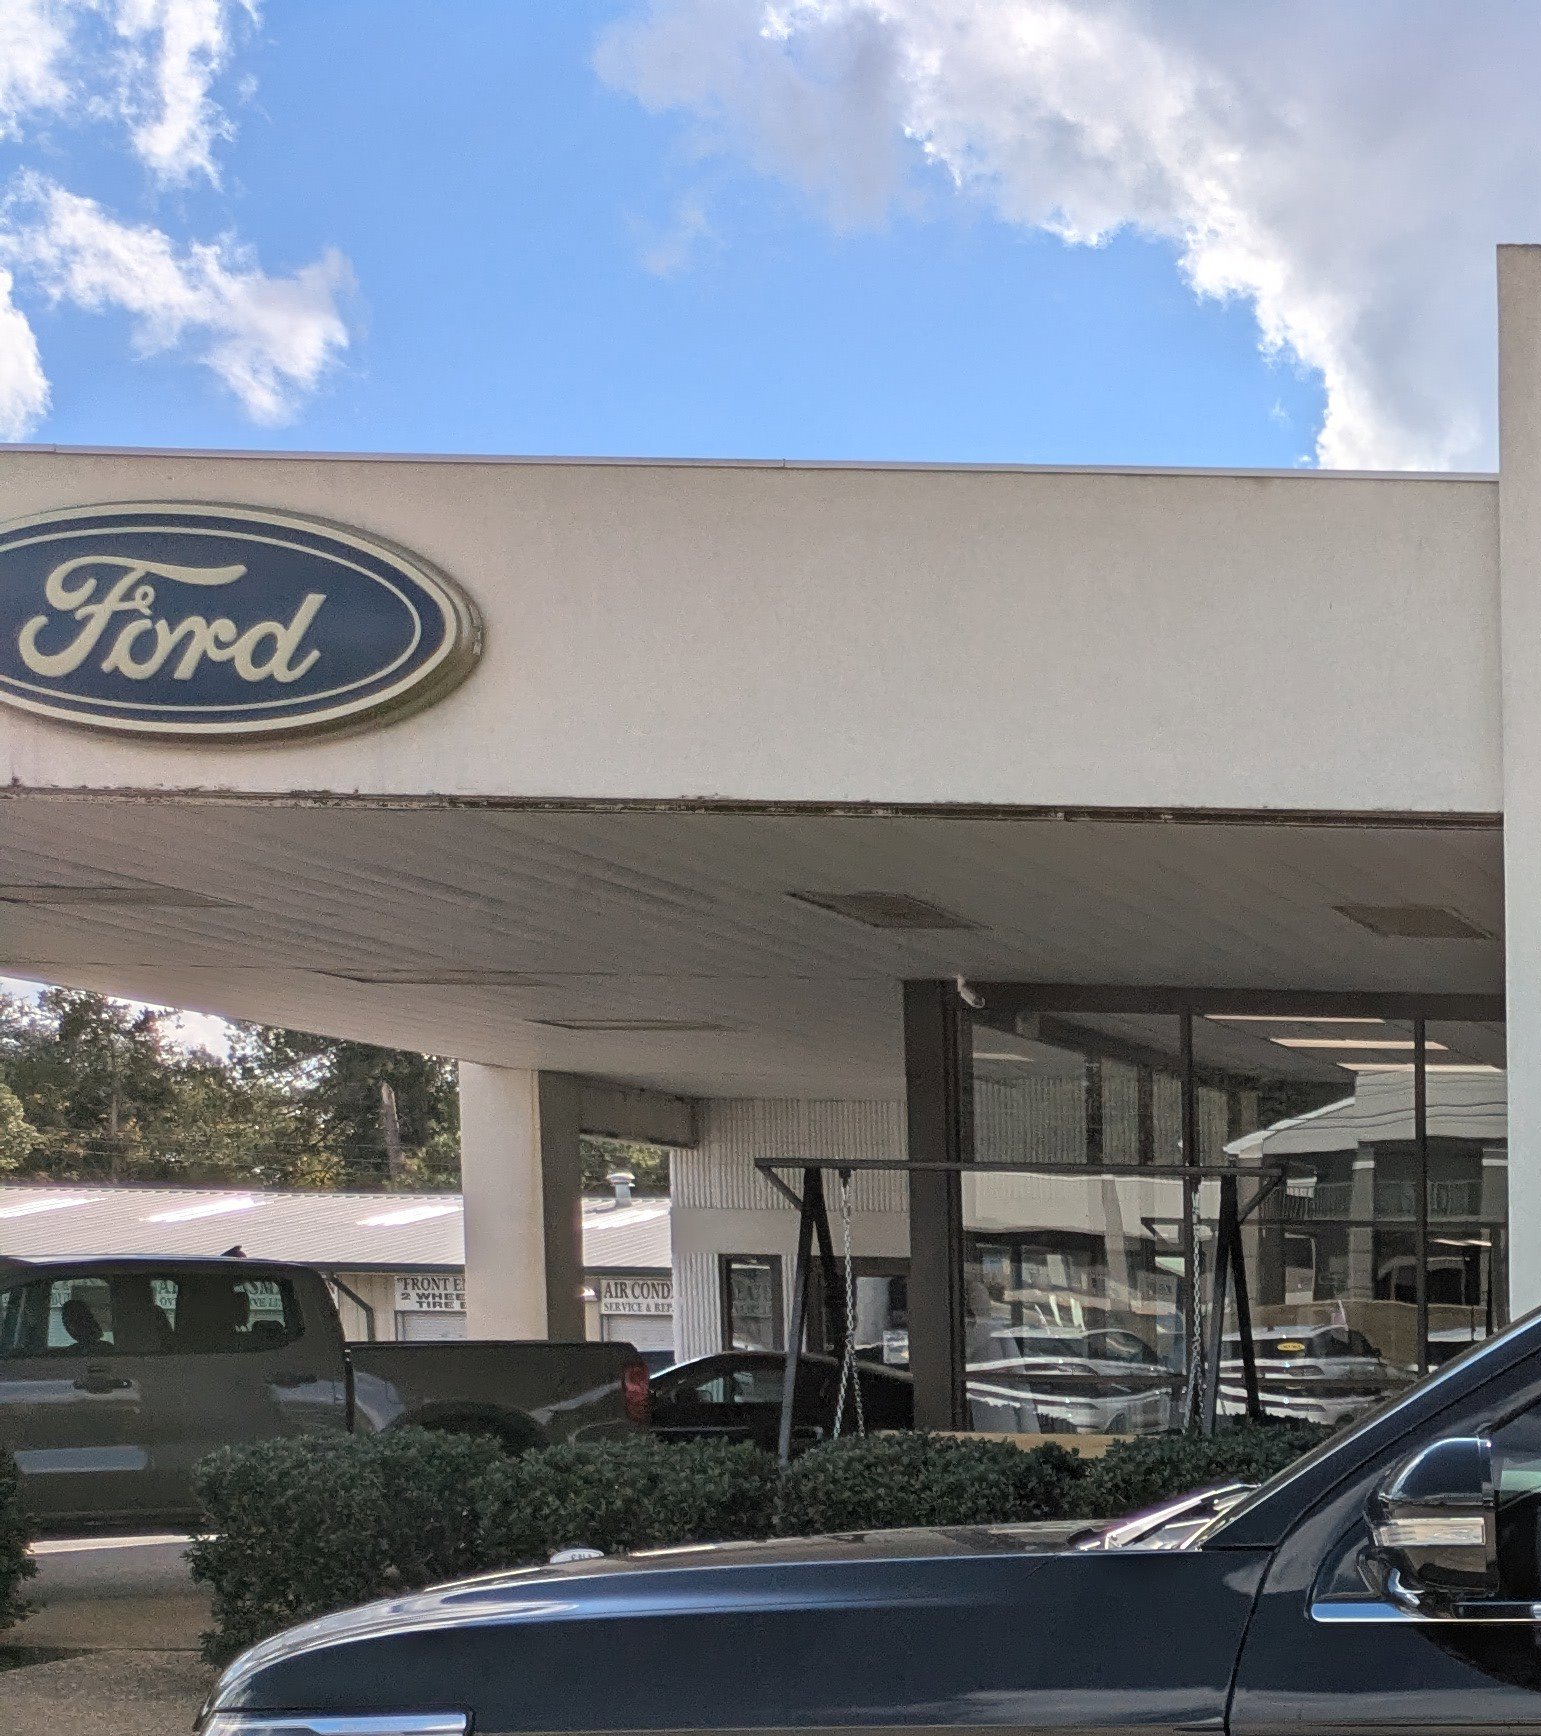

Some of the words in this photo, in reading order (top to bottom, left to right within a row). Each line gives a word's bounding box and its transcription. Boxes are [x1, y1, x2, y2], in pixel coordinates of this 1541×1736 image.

[18, 555, 327, 683] Ford
[603, 1281, 629, 1299] AIR
[401, 1292, 411, 1301] 2
[416, 1300, 455, 1309] TIRE
[603, 1302, 644, 1312] SERVICE
[645, 1303, 652, 1312] &
[654, 1302, 674, 1313] REP
